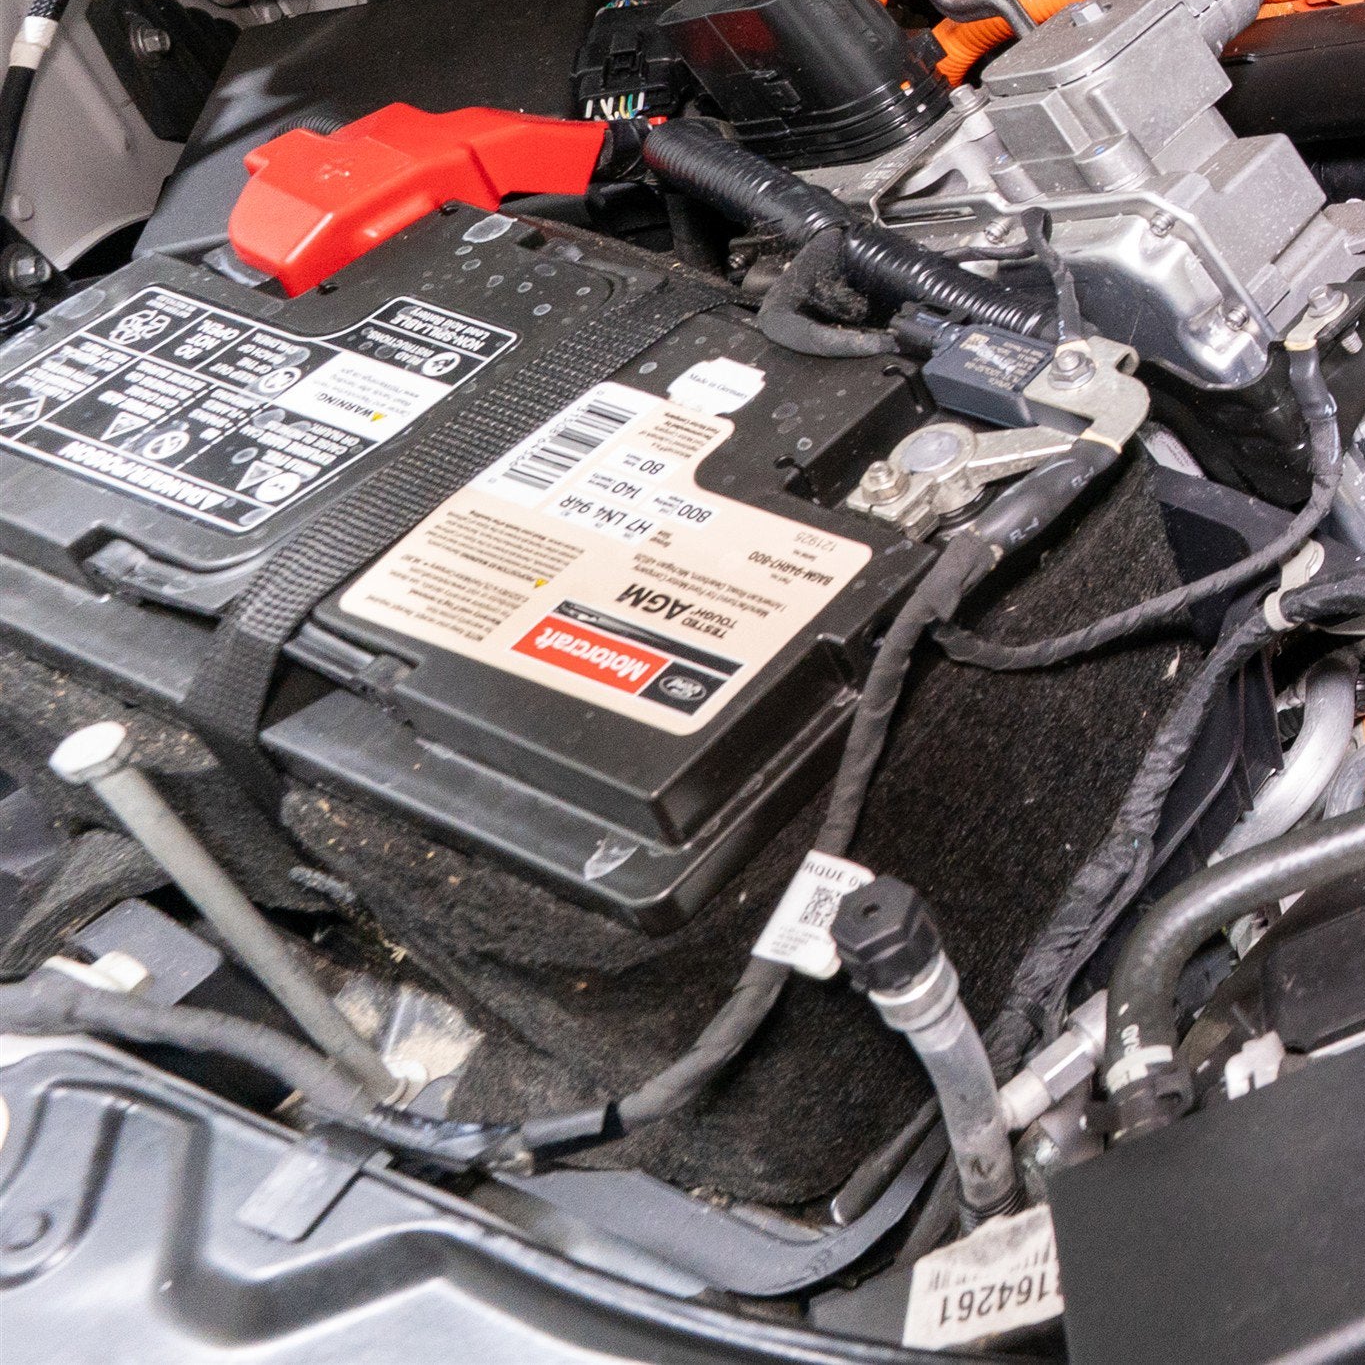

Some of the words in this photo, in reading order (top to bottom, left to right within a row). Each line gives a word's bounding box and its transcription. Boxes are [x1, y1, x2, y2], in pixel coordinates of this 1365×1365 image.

[198, 320, 239, 340] OPEN.
[392, 312, 483, 353] NON-SPILLABLE
[186, 331, 220, 350] NOT
[174, 345, 202, 359] DO
[395, 351, 424, 366] READ
[61, 443, 208, 503] DANGER/POISON
[639, 460, 665, 475] 80
[612, 482, 641, 499] 140
[560, 496, 593, 513] 94R
[678, 504, 712, 523] 800
[595, 507, 627, 525] LN4
[625, 519, 652, 534] H7
[749, 552, 833, 585] BAGM-94RH7-800
[617, 585, 692, 619] AGM
[682, 618, 725, 638] TESTED
[536, 629, 648, 680] Motorcraft
[933, 1271, 1051, 1327] 164261
